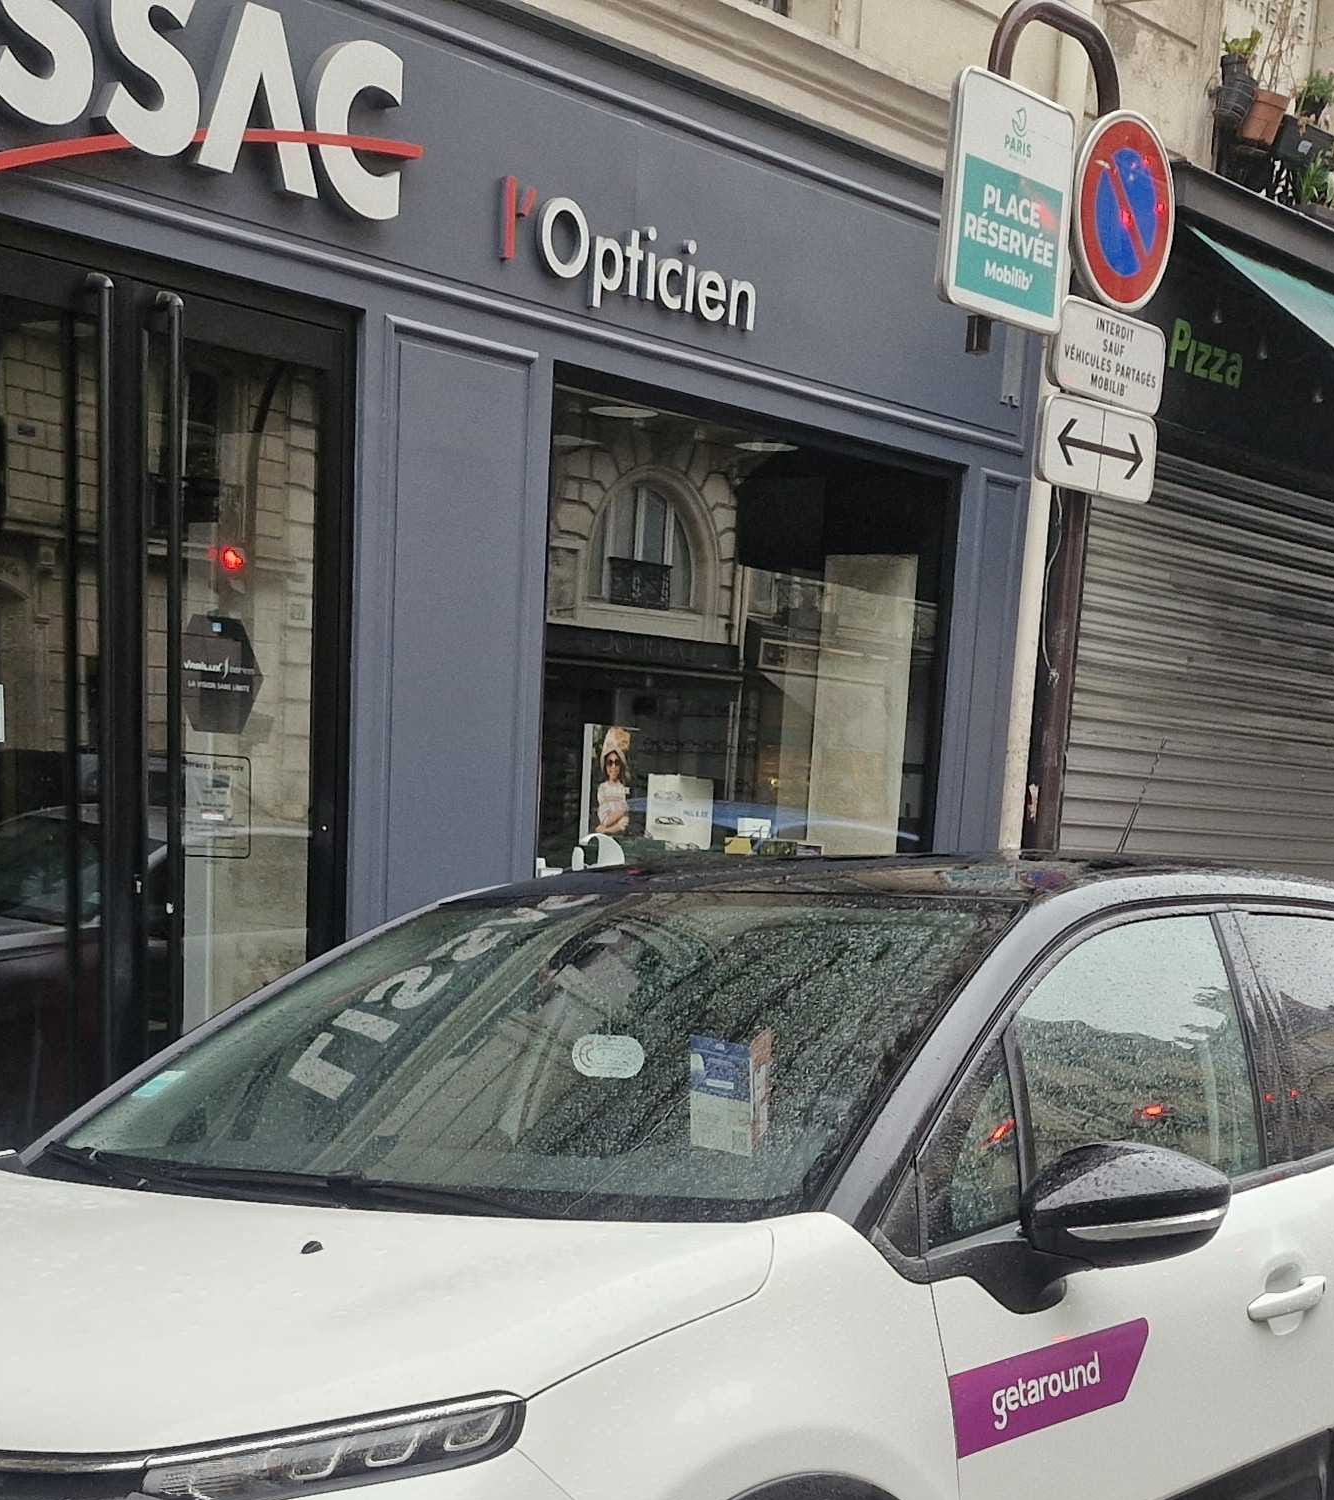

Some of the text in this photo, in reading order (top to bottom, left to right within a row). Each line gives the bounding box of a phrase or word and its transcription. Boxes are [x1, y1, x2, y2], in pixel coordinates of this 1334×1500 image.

[1004, 134, 1032, 158] PARIS
[983, 184, 1041, 228] PLACE
[964, 212, 1054, 267] RÉSERVÉE
[984, 259, 1033, 291] Mobilib'
[1095, 317, 1135, 342] INTERDIT
[1103, 338, 1126, 358] SAUF
[1064, 343, 1157, 390] VÉHICULES PARTAGÉS
[992, 1351, 1101, 1430] getaround
